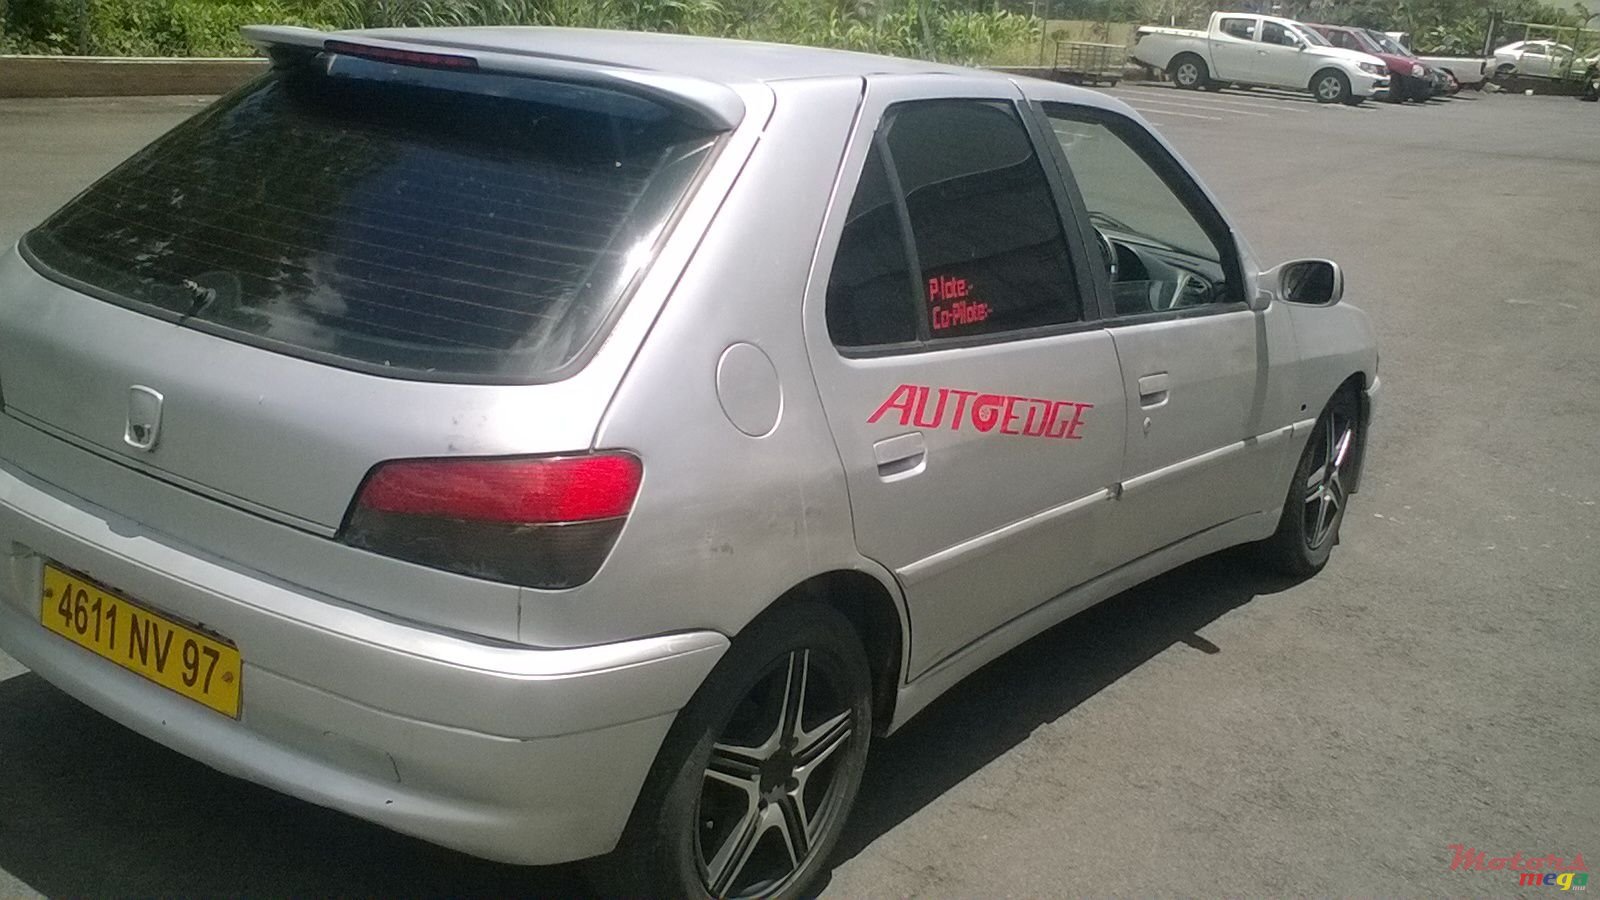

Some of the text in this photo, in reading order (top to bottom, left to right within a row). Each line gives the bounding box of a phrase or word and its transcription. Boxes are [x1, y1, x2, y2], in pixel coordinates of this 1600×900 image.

[58, 583, 220, 694] 4611 NV 97
